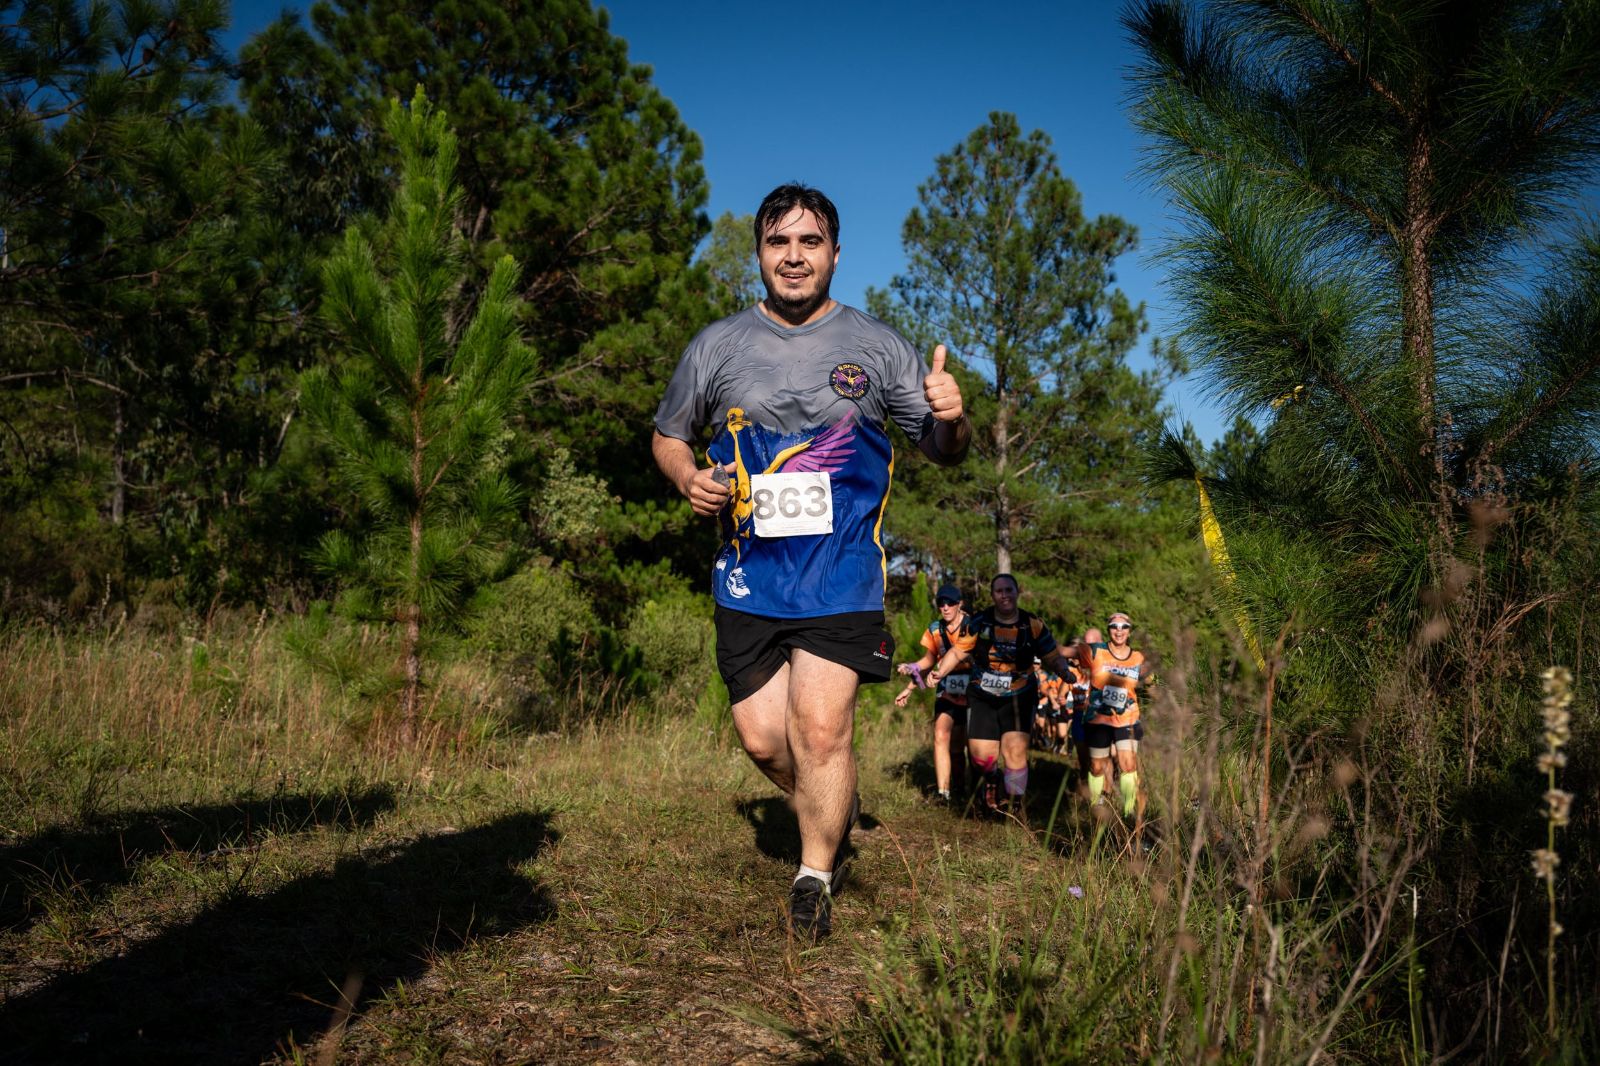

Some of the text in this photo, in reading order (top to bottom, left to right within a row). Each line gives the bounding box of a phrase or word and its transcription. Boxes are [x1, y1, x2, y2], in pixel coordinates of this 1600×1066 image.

[753, 485, 828, 520] 863
[982, 678, 1010, 689] 2160
[1104, 689, 1126, 703] 289
